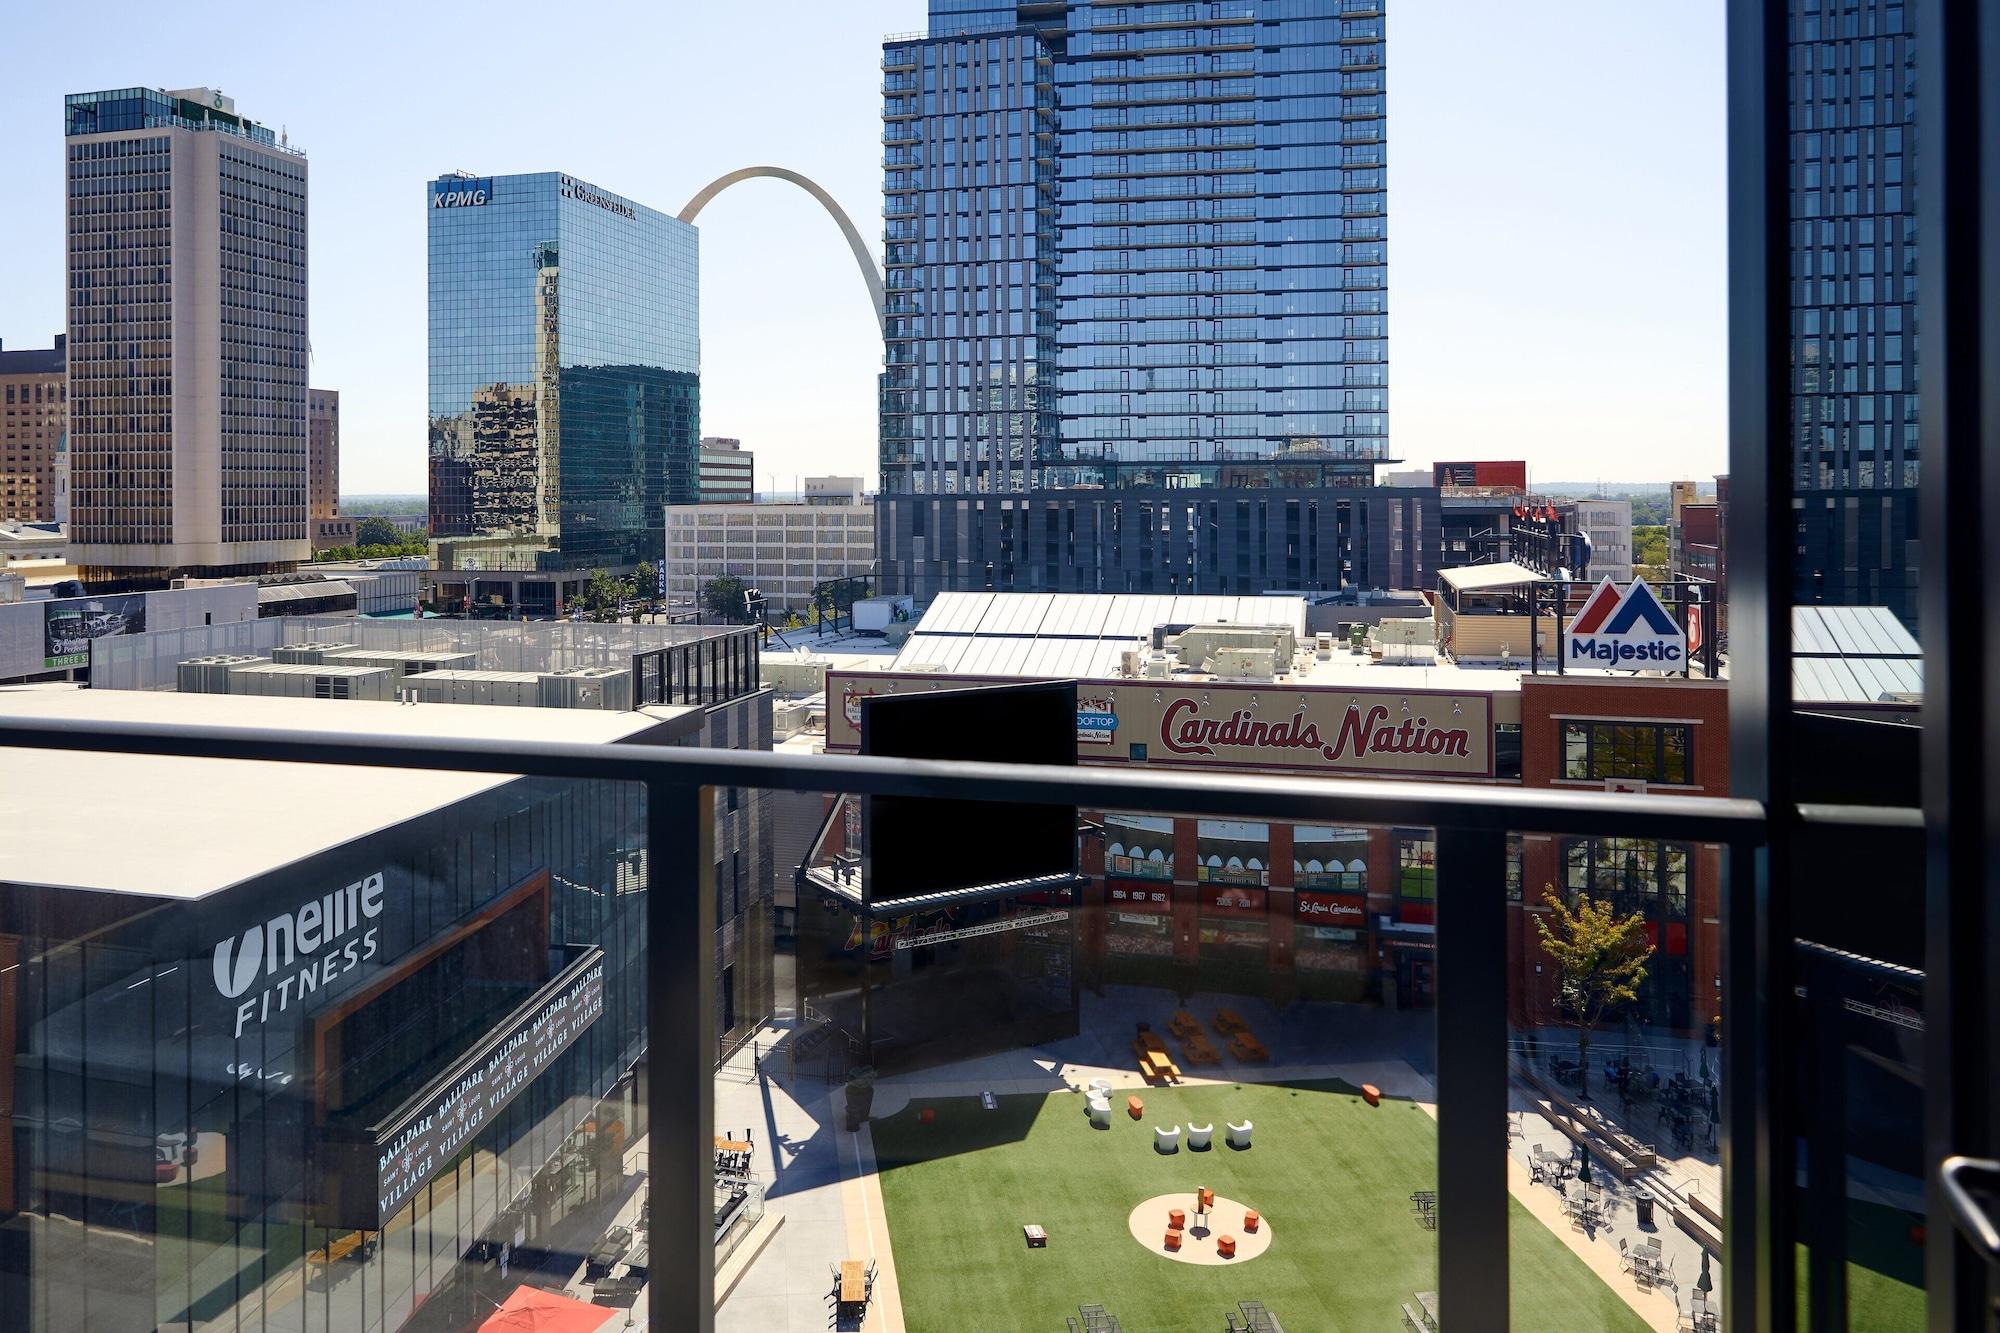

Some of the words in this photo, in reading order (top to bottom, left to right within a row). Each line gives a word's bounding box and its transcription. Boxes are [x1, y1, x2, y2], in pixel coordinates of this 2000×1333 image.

[433, 190, 485, 208] KPMG
[53, 655, 79, 666] THREE
[1572, 638, 1681, 666] Majestic
[1077, 716, 1113, 726] OOFTOP
[1161, 699, 1326, 756] Cardinals
[1322, 704, 1471, 761] Nation
[1132, 892, 1146, 900] 1967
[1152, 893, 1165, 902] 1982
[1330, 903, 1362, 914] Cardinals
[235, 927, 378, 1039] FITNESS
[571, 966, 602, 1000] BALLPARK
[533, 996, 567, 1034] BALLPARK
[572, 997, 602, 1031] VILLAGE
[489, 1030, 528, 1073] BALLPARK
[534, 1029, 567, 1067] VILLAGE
[439, 1069, 483, 1119] BALLPARK
[490, 1066, 528, 1108] VILLAGE
[440, 1107, 483, 1156] VILLAGE
[442, 1117, 455, 1133] SAINT
[468, 1093, 481, 1108] LOUIS
[379, 1115, 433, 1172] BALLPARK
[383, 1168, 398, 1187] SAINT
[415, 1141, 430, 1157] LOUIS
[381, 1156, 433, 1212] VILLAGE
